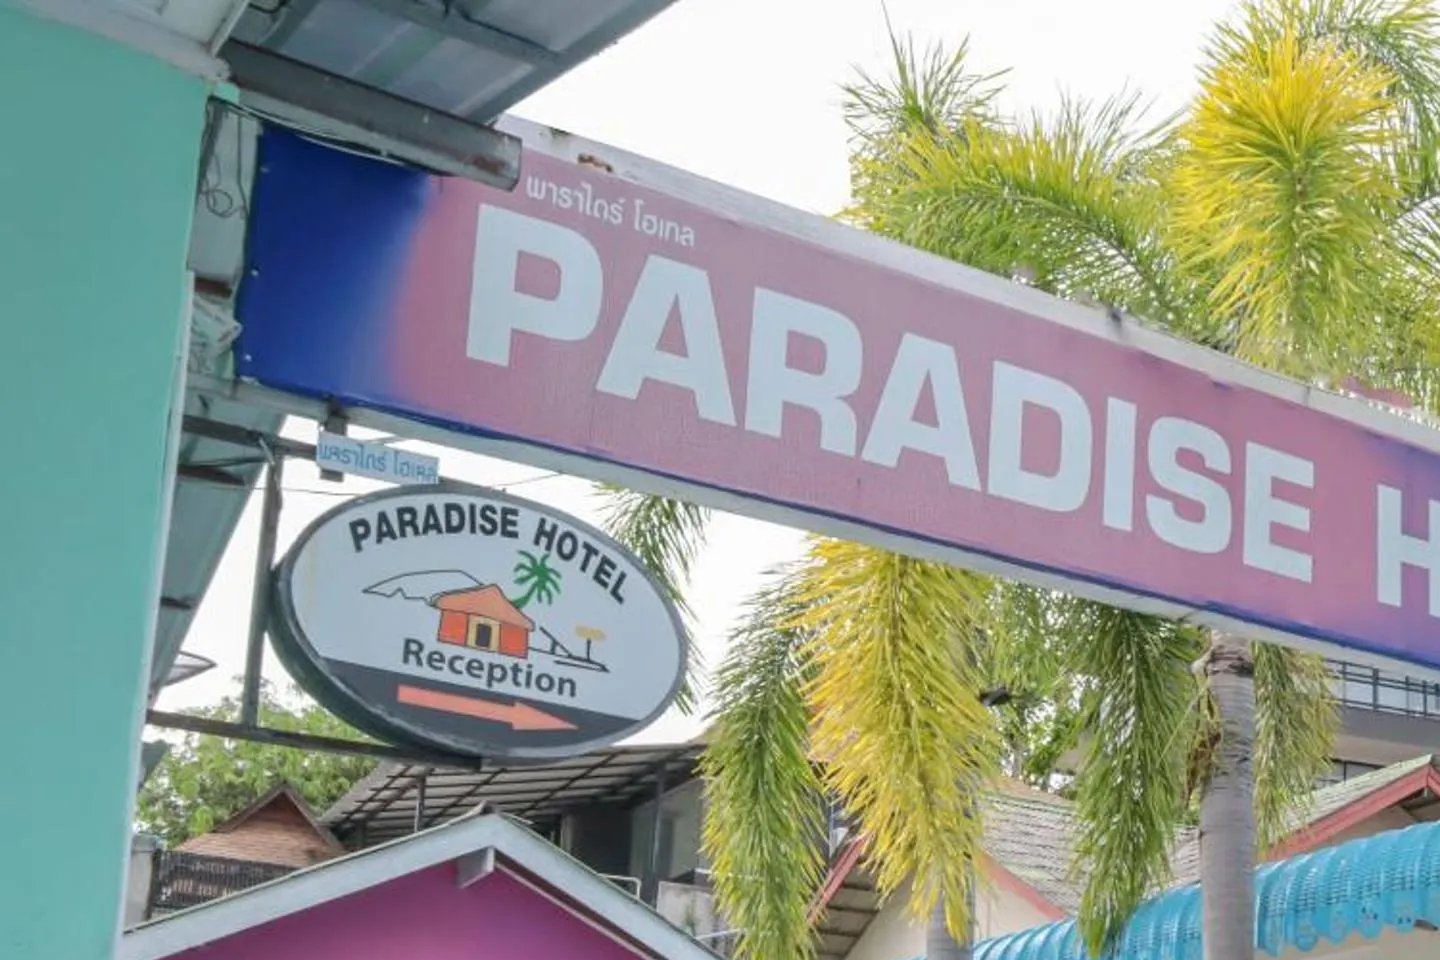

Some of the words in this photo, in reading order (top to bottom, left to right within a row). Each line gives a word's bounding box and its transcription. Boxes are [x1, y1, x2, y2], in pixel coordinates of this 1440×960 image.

[466, 203, 1316, 583] PARADISE
[349, 502, 520, 553] PARADISE
[532, 516, 628, 605] HOTEL
[401, 637, 577, 698] Reception
